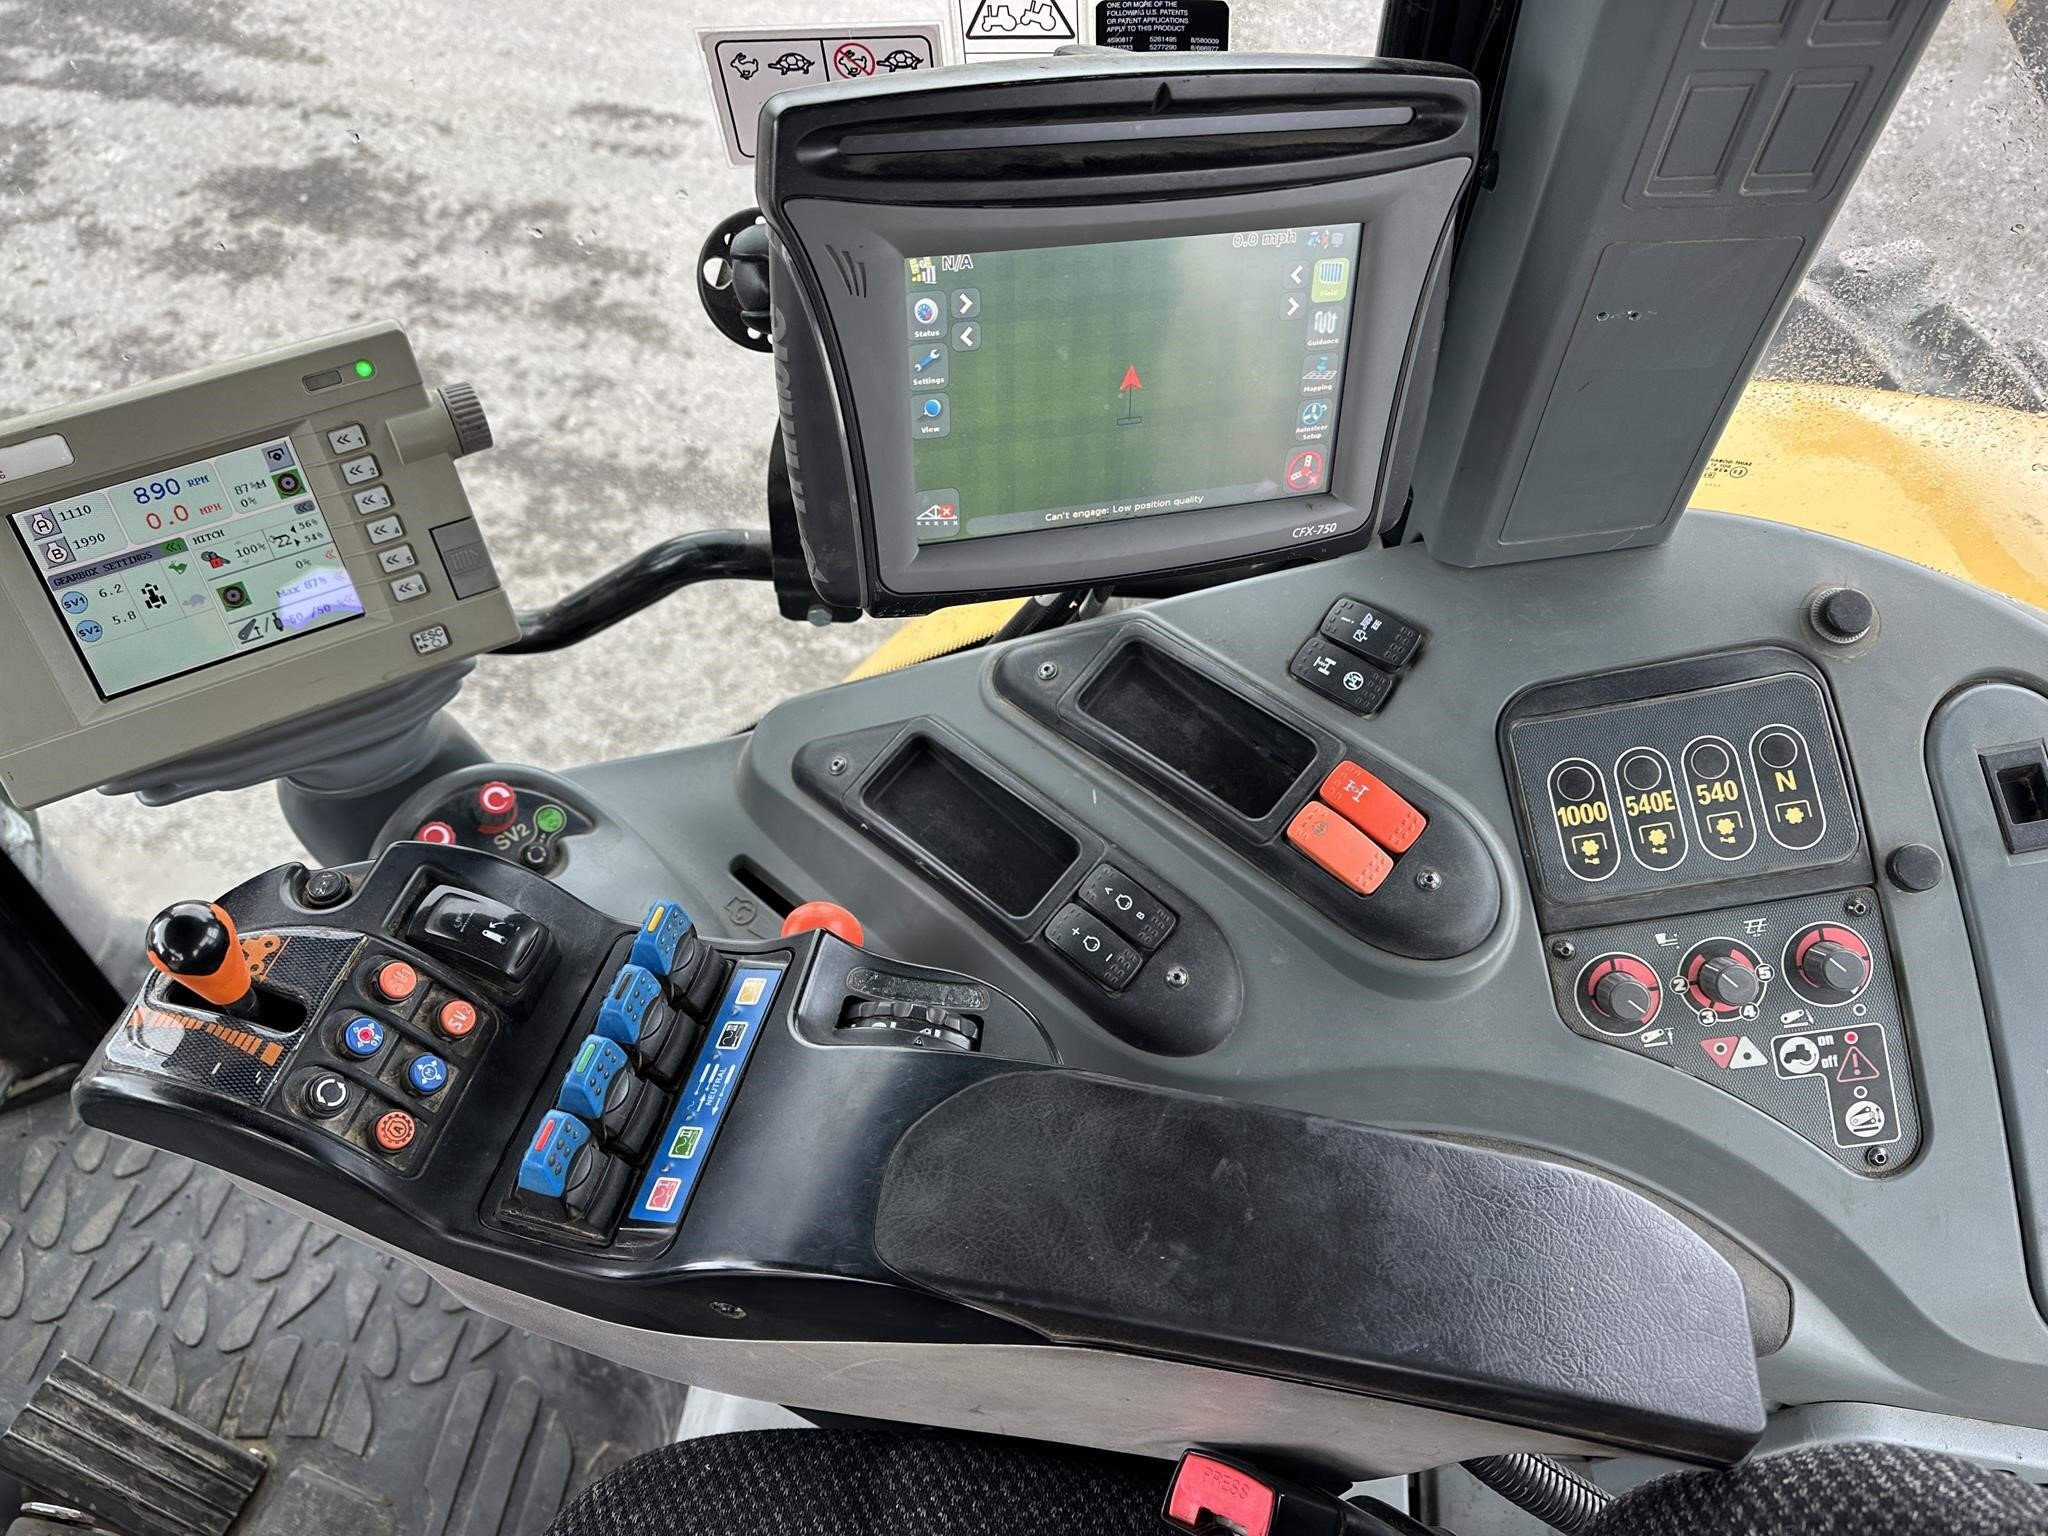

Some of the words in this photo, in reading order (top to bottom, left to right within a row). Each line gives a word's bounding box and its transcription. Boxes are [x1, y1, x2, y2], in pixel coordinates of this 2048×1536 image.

[1106, 1, 1121, 9] ONE
[1106, 9, 1145, 17] FOLLOWING
[1106, 17, 1117, 25] OR
[1106, 25, 1126, 33] APPLY
[1232, 232, 1259, 248] 0.0
[1262, 229, 1297, 248] mph
[941, 254, 974, 272] N/A
[914, 330, 940, 338] Status
[1307, 338, 1339, 347] Guidance
[912, 376, 945, 386] Settings
[1303, 383, 1333, 393] Mapping
[921, 425, 940, 434] View
[1295, 424, 1328, 434] Autosteer
[358, 436, 365, 446] 1
[1302, 433, 1322, 441] Setup
[369, 467, 378, 476] 2
[133, 478, 181, 505] 890
[187, 474, 211, 488] RPM
[381, 497, 389, 506] 3
[1045, 512, 1070, 522] Can't
[1072, 507, 1110, 519] engage:
[1112, 504, 1132, 514] Low
[1134, 499, 1171, 512] position
[1174, 495, 1205, 506] quality
[58, 504, 92, 522] 1110
[146, 504, 190, 530] 0.0
[200, 503, 223, 516] MPH
[36, 519, 50, 533] A
[393, 527, 401, 535] 4
[1292, 522, 1338, 538] CFX-750
[73, 533, 106, 550] 1990
[191, 529, 226, 545] HITCH
[51, 548, 65, 561] B
[406, 555, 413, 565] 5
[53, 567, 100, 588] GEARBOX
[102, 551, 153, 573] SETTINGS
[98, 583, 124, 599] 6.2
[63, 596, 86, 610] SV1
[112, 610, 137, 626] 5.8
[78, 625, 101, 639] SV2
[420, 627, 444, 643] ESC
[1773, 769, 1798, 793] N
[1696, 779, 1740, 806] 540
[1625, 789, 1676, 818] 540E
[1556, 800, 1609, 828] 1000
[493, 823, 531, 851] SV2
[1135, 911, 1146, 920] B
[1758, 967, 1771, 979] 5
[1673, 979, 1686, 992] 2
[447, 1004, 473, 1031] SV2
[1702, 1011, 1714, 1023] 3
[1743, 1006, 1756, 1018] 4
[1817, 1034, 1835, 1047] on
[1820, 1054, 1839, 1069] off
[704, 1065, 728, 1107] NEUTRAL
[1203, 1466, 1250, 1500] PRESS
